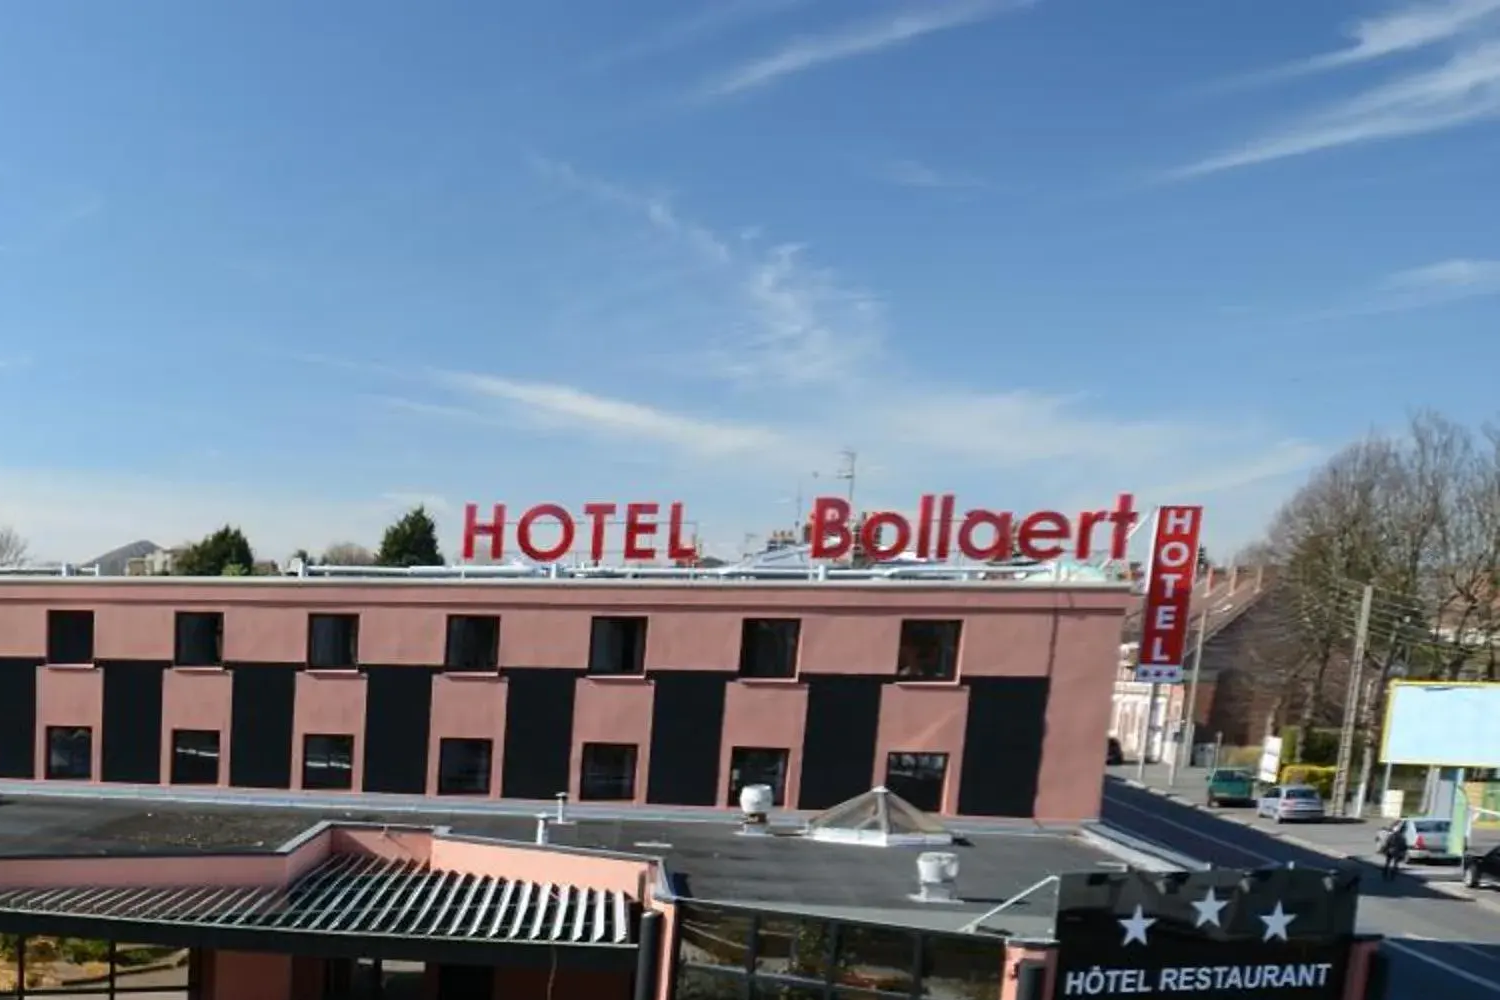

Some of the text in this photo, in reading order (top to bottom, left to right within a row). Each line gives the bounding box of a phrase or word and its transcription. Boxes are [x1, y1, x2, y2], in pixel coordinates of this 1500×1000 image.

[462, 494, 1138, 562] HOTEL Bollaert
[1152, 509, 1193, 662] HOTEL
[1064, 963, 1332, 995] HÔTEL RESTAURANT
